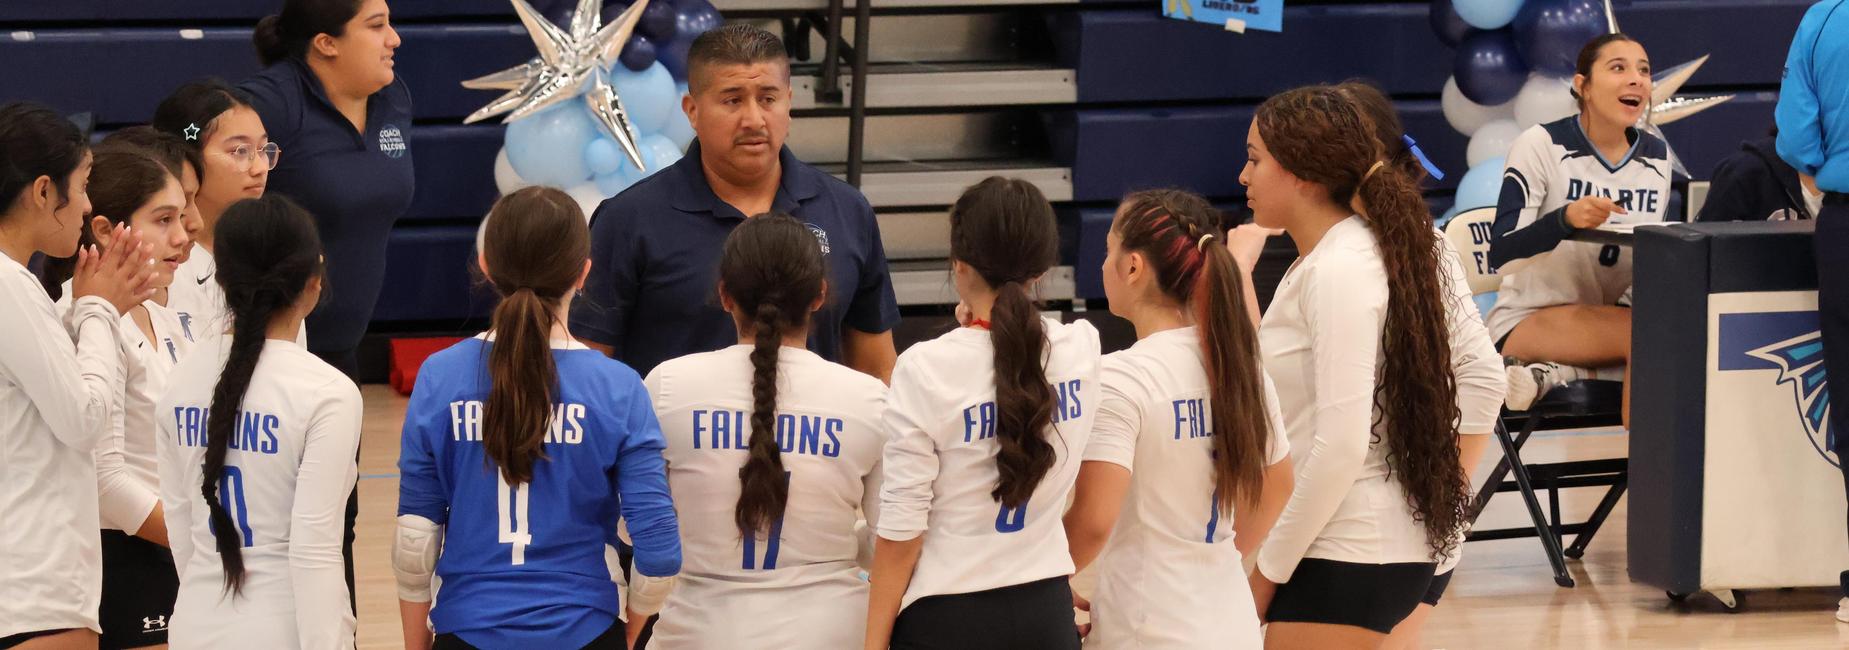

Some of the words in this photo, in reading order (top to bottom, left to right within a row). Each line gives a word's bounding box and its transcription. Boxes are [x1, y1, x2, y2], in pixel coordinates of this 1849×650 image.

[174, 407, 279, 454] FALONS
[450, 400, 586, 444] FANS
[693, 410, 843, 458] FALONS
[963, 379, 1082, 443] FANS
[498, 466, 532, 566] 4
